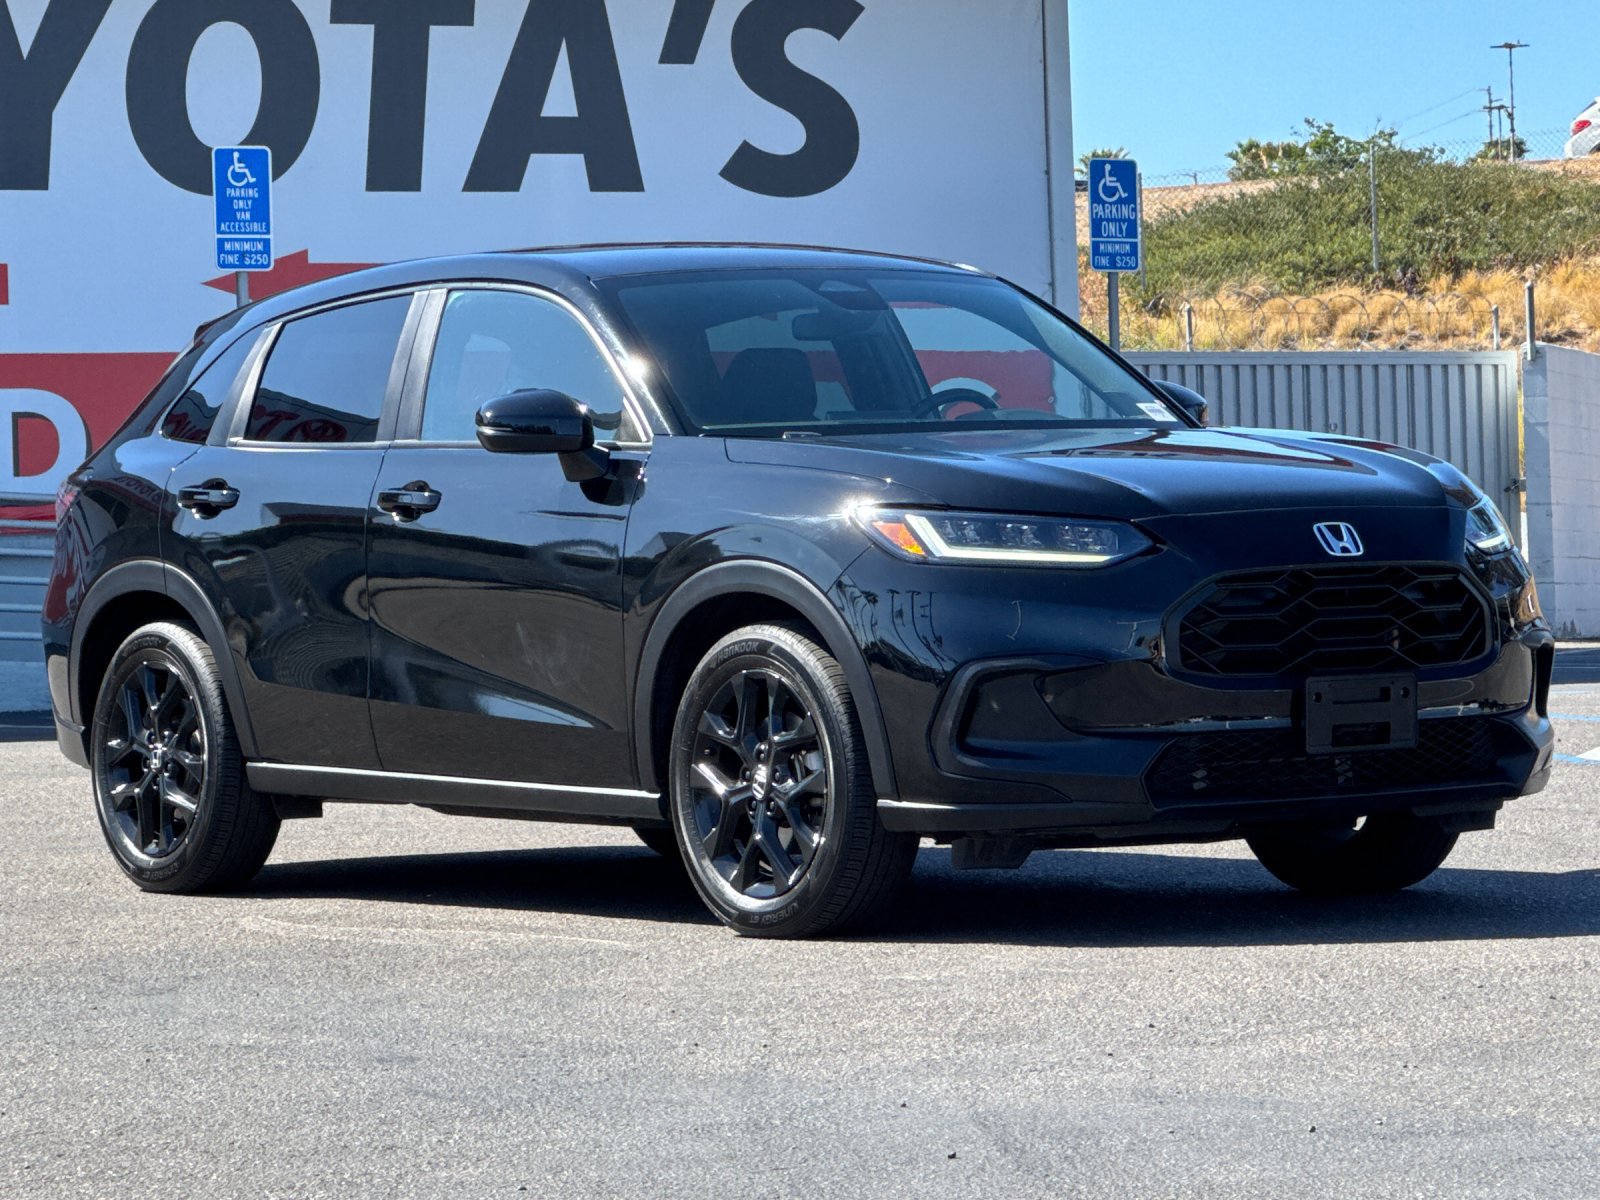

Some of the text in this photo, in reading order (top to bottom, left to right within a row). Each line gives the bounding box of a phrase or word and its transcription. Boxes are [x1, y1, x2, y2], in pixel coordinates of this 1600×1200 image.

[226, 187, 259, 198] PARKING
[233, 199, 252, 209] ONLY
[236, 211, 250, 221] VAN
[1092, 203, 1136, 220] PARKING
[220, 222, 267, 232] ACCESSIBLE
[1101, 221, 1128, 237] ONLY
[224, 241, 263, 252] MINIMUM
[1099, 242, 1131, 254] MINIMUM
[220, 254, 269, 265] FINE $250
[1094, 256, 1136, 267] FINE $250
